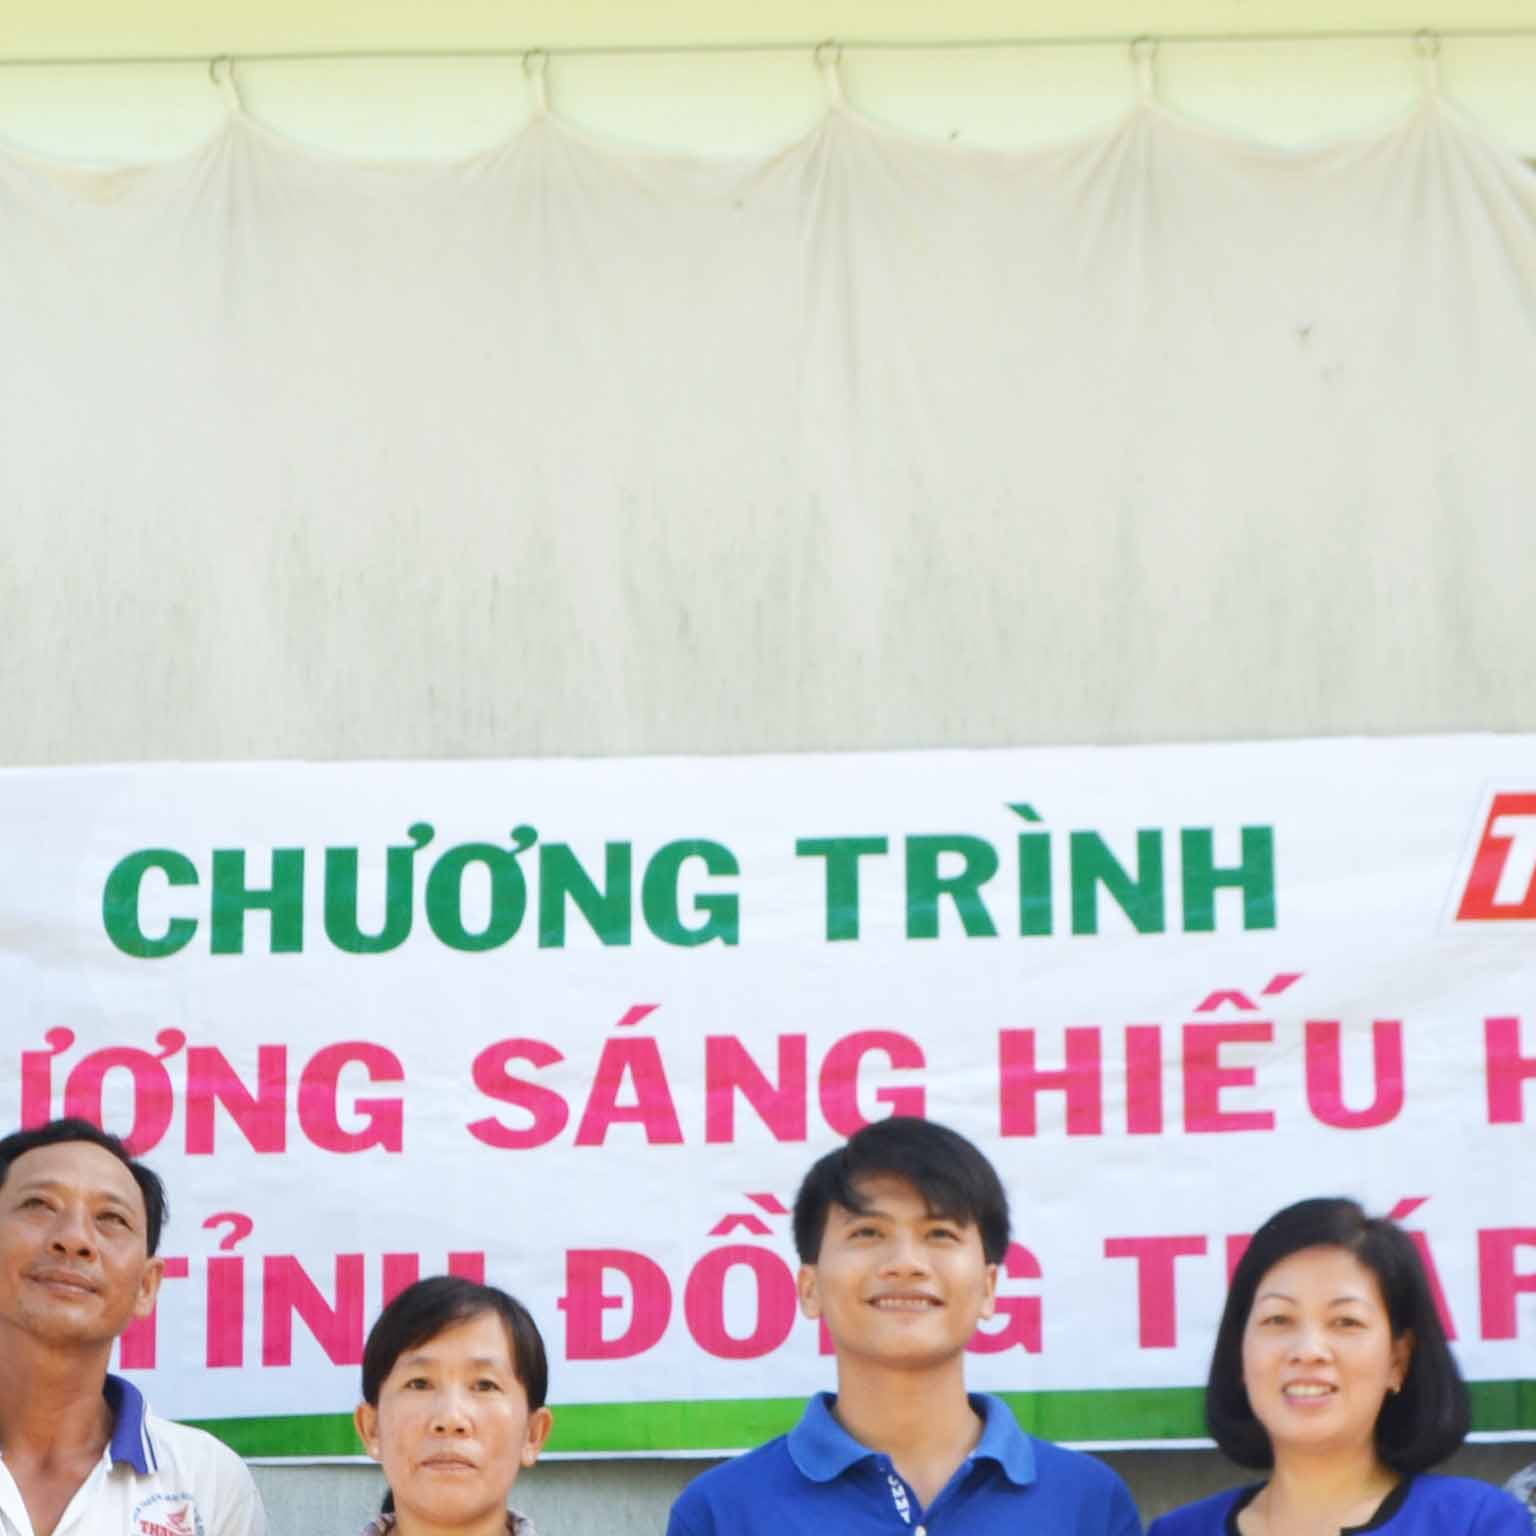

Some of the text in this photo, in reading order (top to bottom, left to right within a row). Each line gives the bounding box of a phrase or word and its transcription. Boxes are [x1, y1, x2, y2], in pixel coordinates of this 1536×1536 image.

[102, 803, 1276, 958] CHƯƠNG TRÌNH
[465, 1003, 926, 1149] SÁNG
[999, 974, 1404, 1137] HIẾU
[119, 1212, 485, 1370] TỈN
[558, 1192, 1043, 1361] ĐỒG
